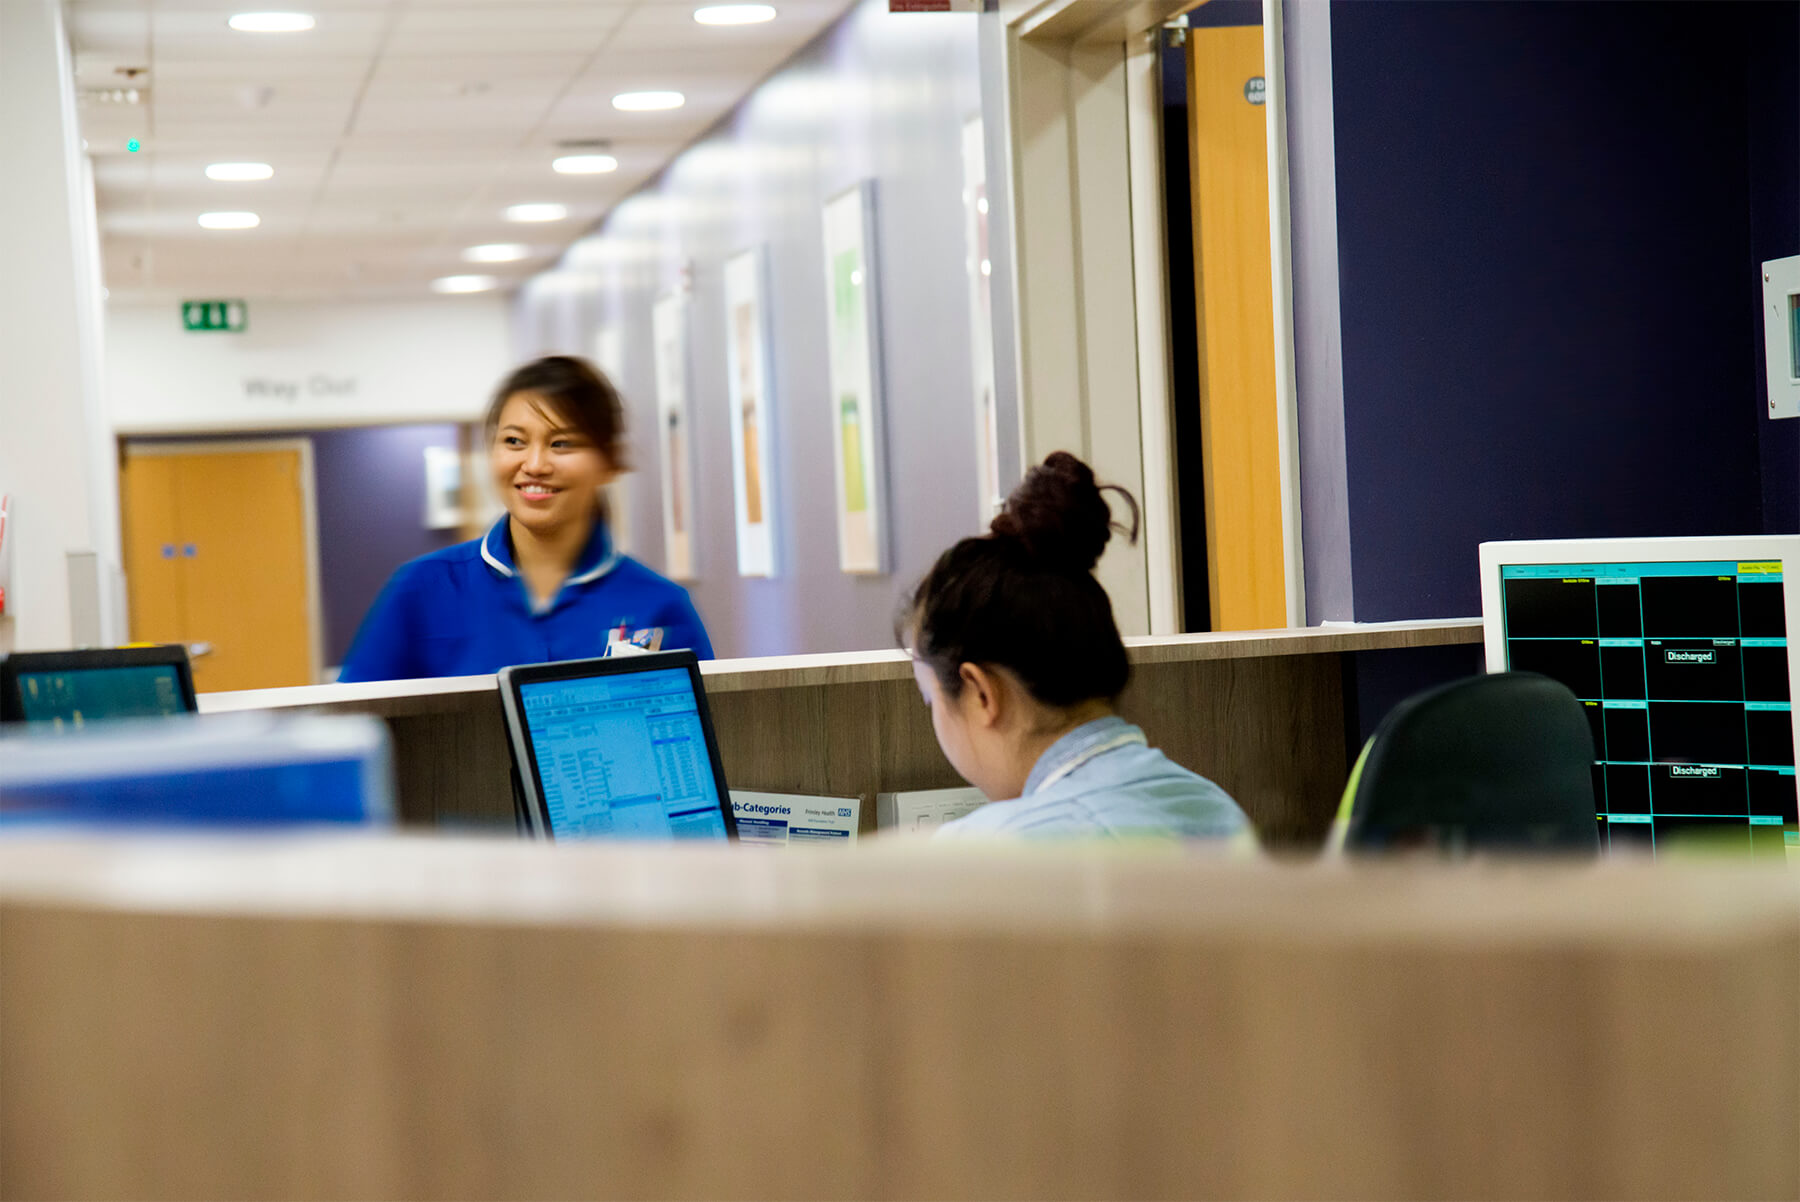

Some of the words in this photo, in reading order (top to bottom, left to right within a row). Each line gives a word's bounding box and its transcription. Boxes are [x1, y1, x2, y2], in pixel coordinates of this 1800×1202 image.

[1250, 79, 1265, 90] FD
[243, 378, 299, 404] Way
[1667, 651, 1713, 663] Discharged
[1672, 765, 1718, 778] Discharged
[732, 801, 792, 816] b-Categories
[838, 808, 852, 817] NHS
